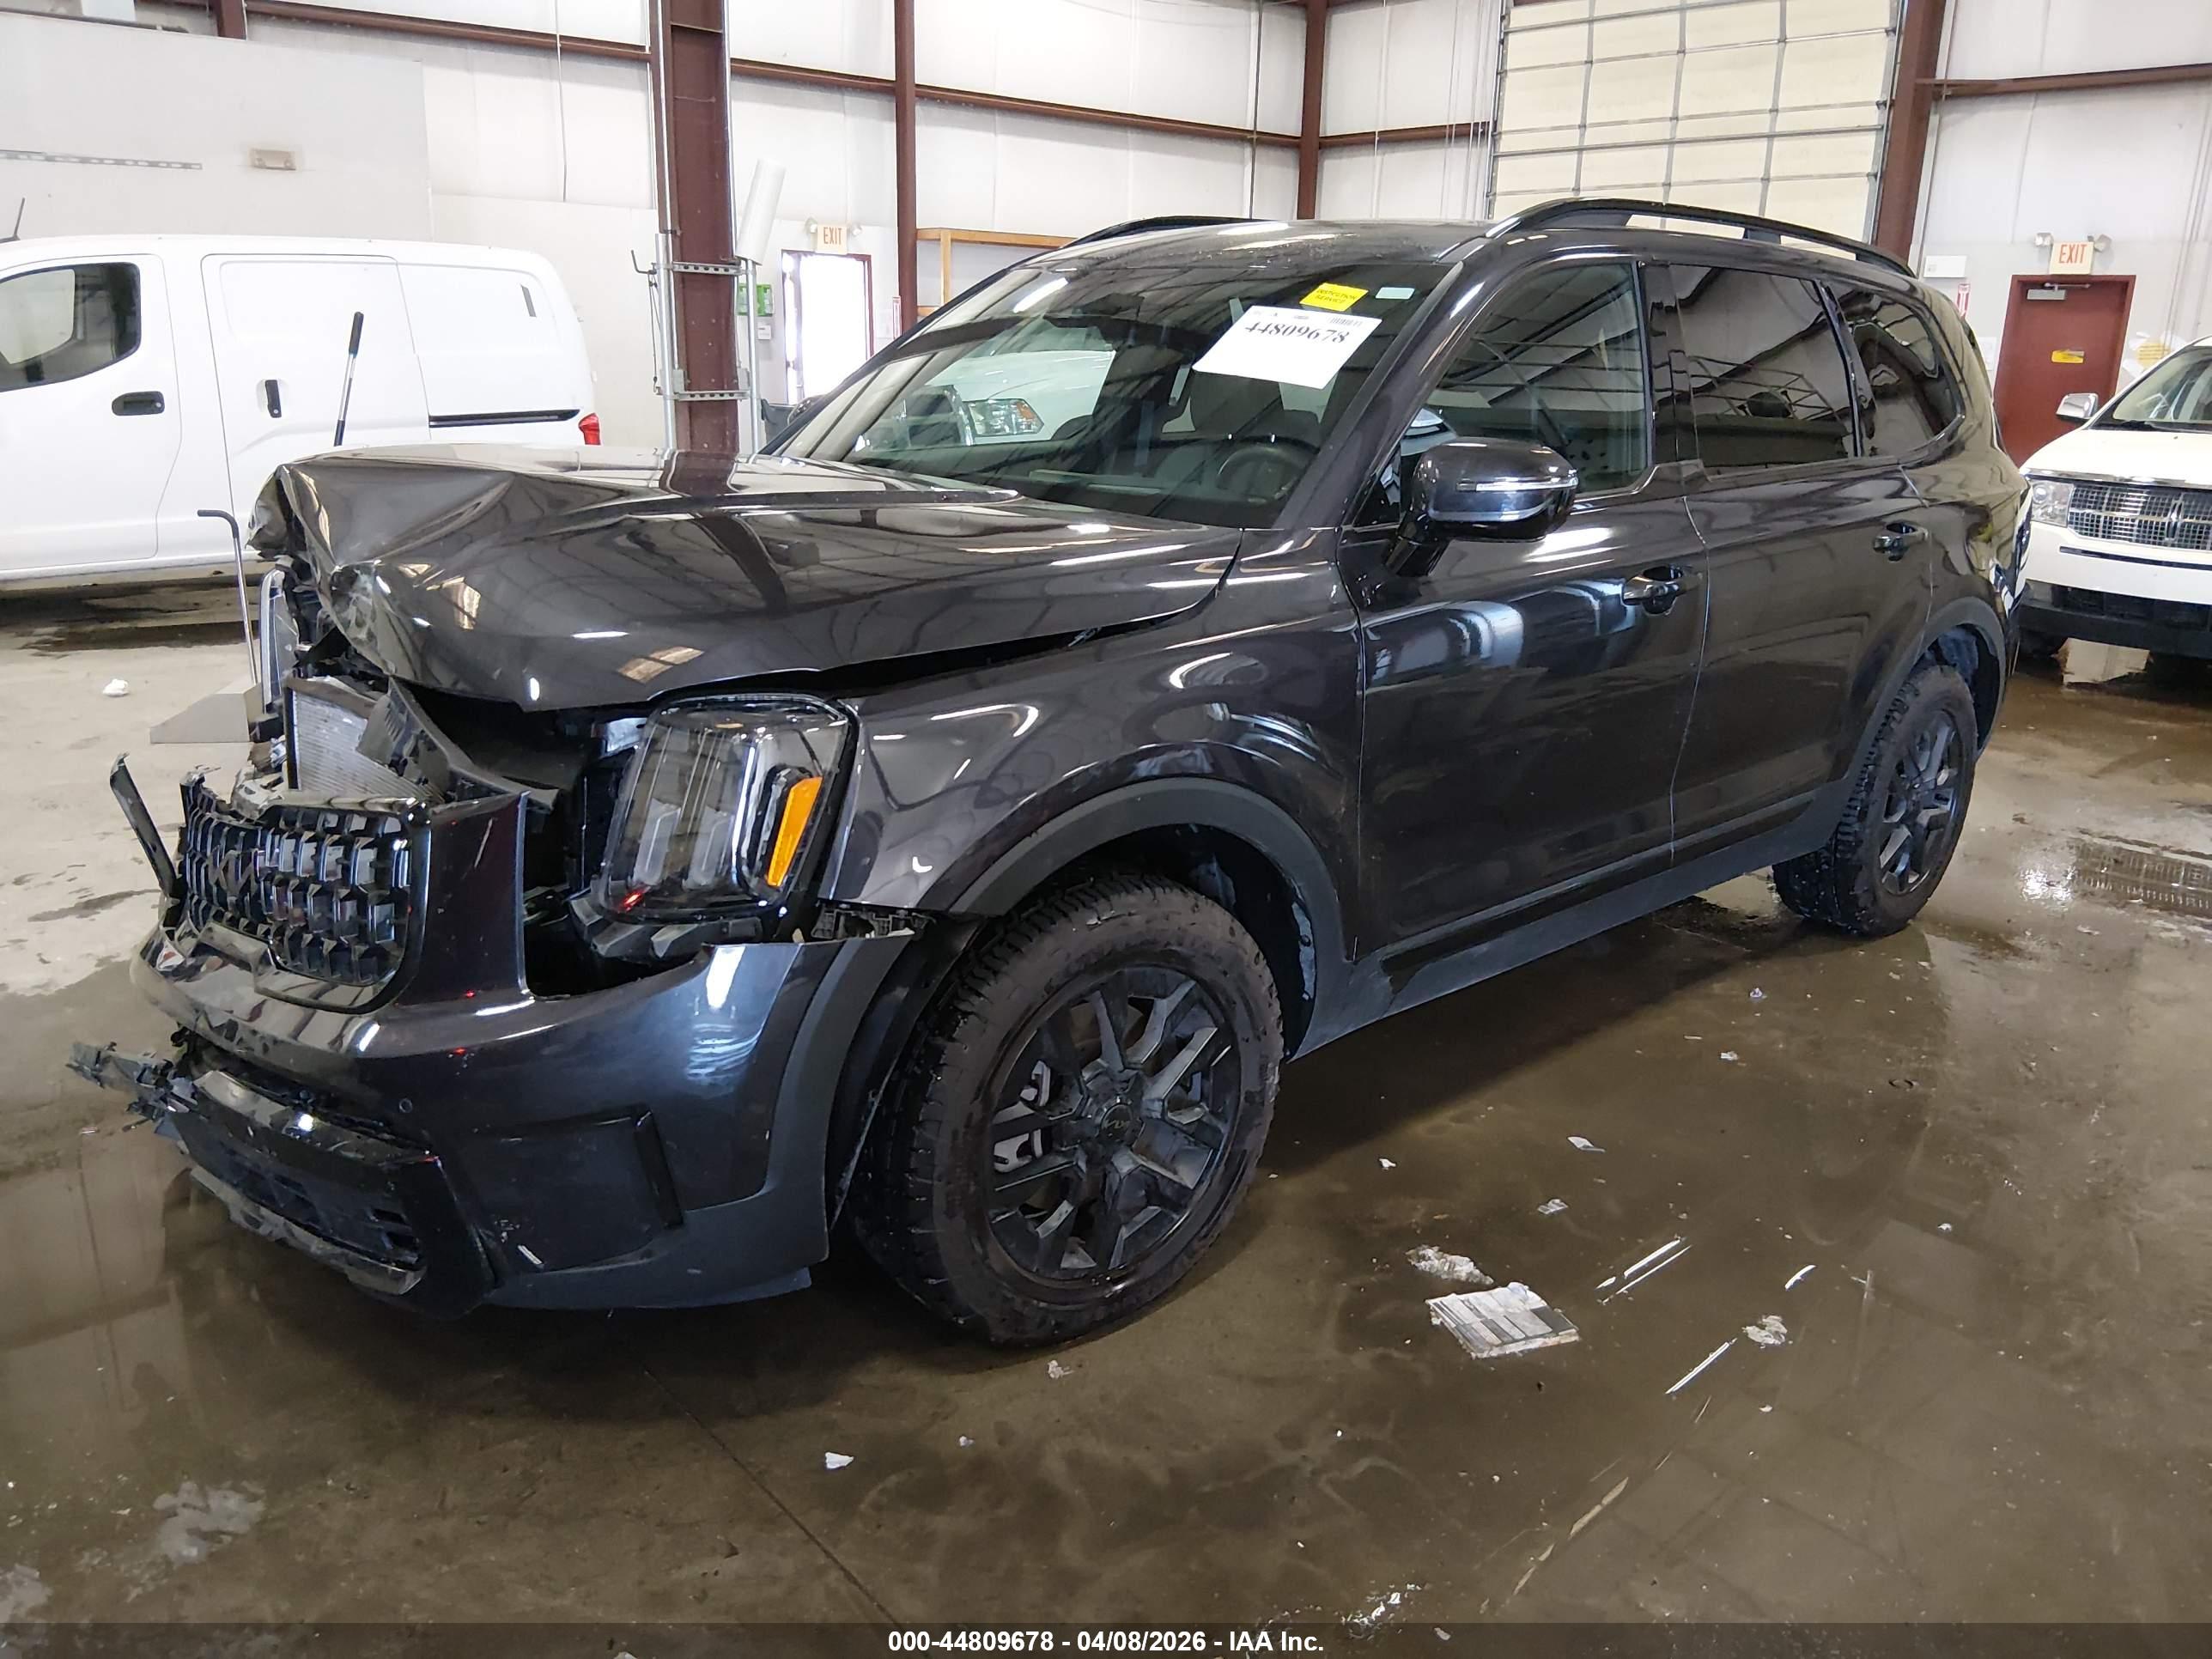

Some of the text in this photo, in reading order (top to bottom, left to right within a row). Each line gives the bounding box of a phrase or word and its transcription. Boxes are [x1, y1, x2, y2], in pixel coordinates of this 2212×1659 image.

[823, 226, 842, 245] EXIT
[2058, 244, 2087, 264] EXIT
[1245, 321, 1350, 343] 44809678
